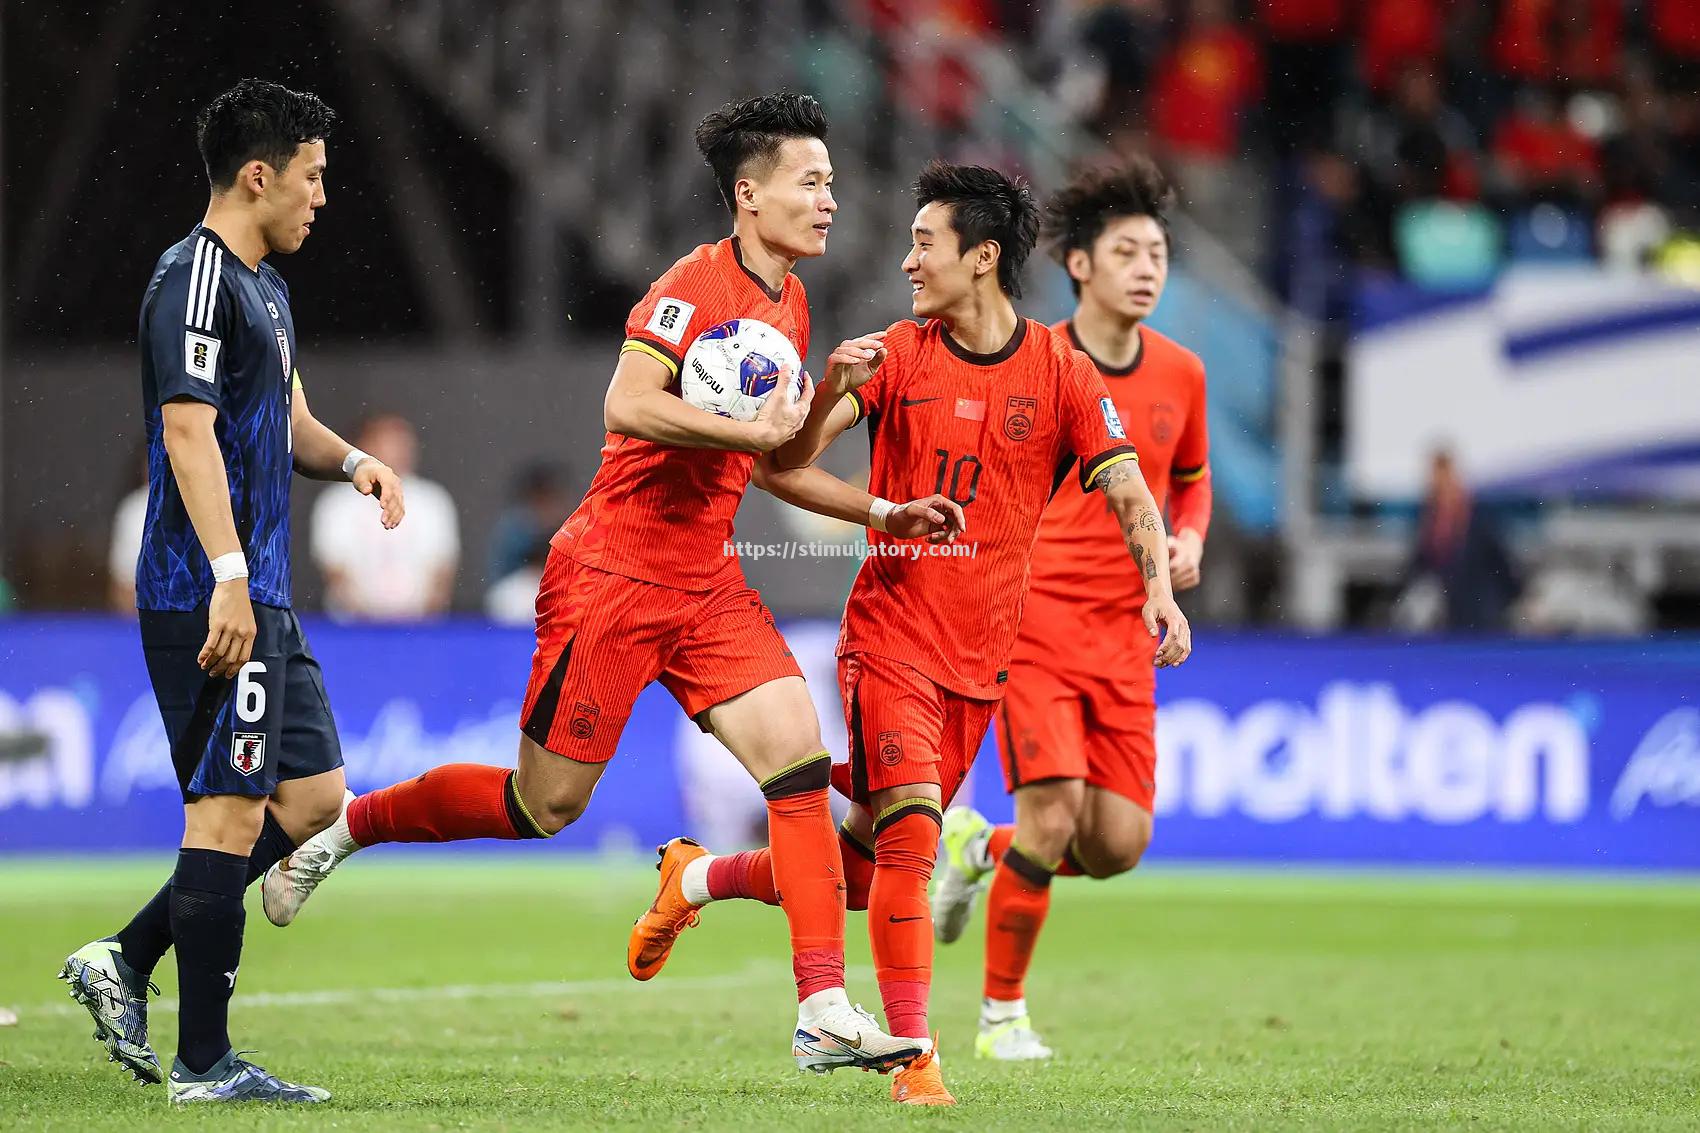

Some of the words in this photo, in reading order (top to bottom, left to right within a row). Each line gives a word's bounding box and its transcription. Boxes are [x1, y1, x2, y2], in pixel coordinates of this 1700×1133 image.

[691, 357, 724, 395] molten
[1009, 398, 1036, 410] CFA
[934, 448, 984, 508] 10
[235, 661, 267, 723] 6
